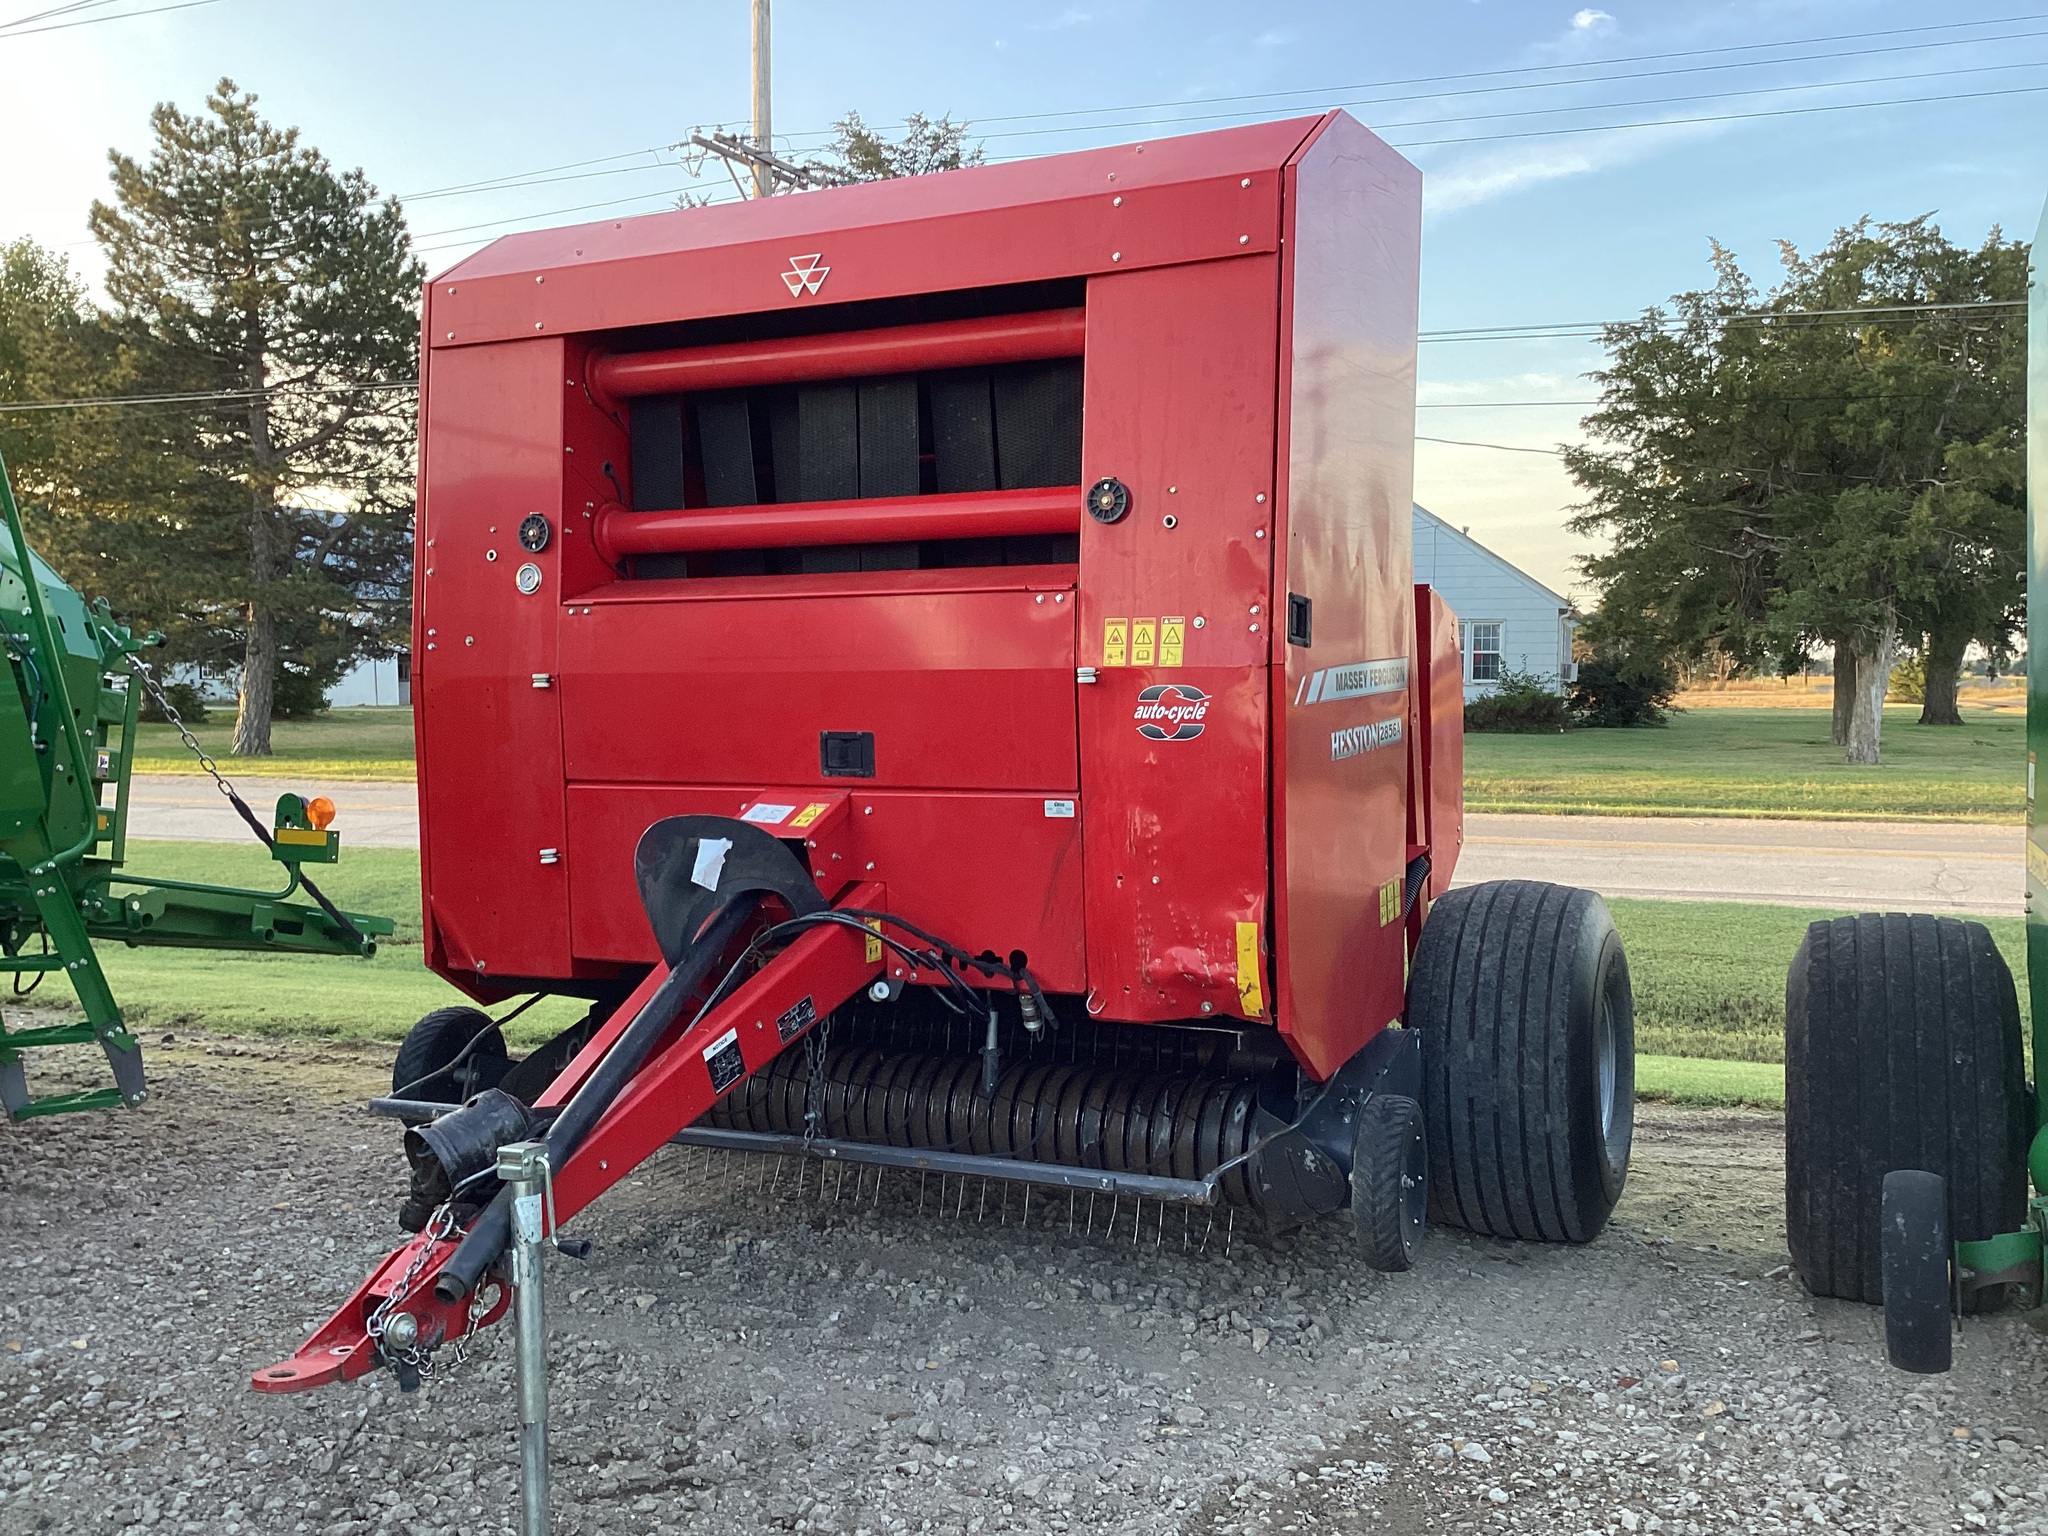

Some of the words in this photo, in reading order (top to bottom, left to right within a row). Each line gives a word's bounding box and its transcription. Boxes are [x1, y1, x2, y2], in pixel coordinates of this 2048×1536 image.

[1335, 669, 1368, 692] MASSEY
[1369, 665, 1405, 687] FERGUSON
[1133, 701, 1206, 724] auto-cycle
[1330, 721, 1380, 761] HESSTON
[712, 1036, 728, 1052] NOTICE
